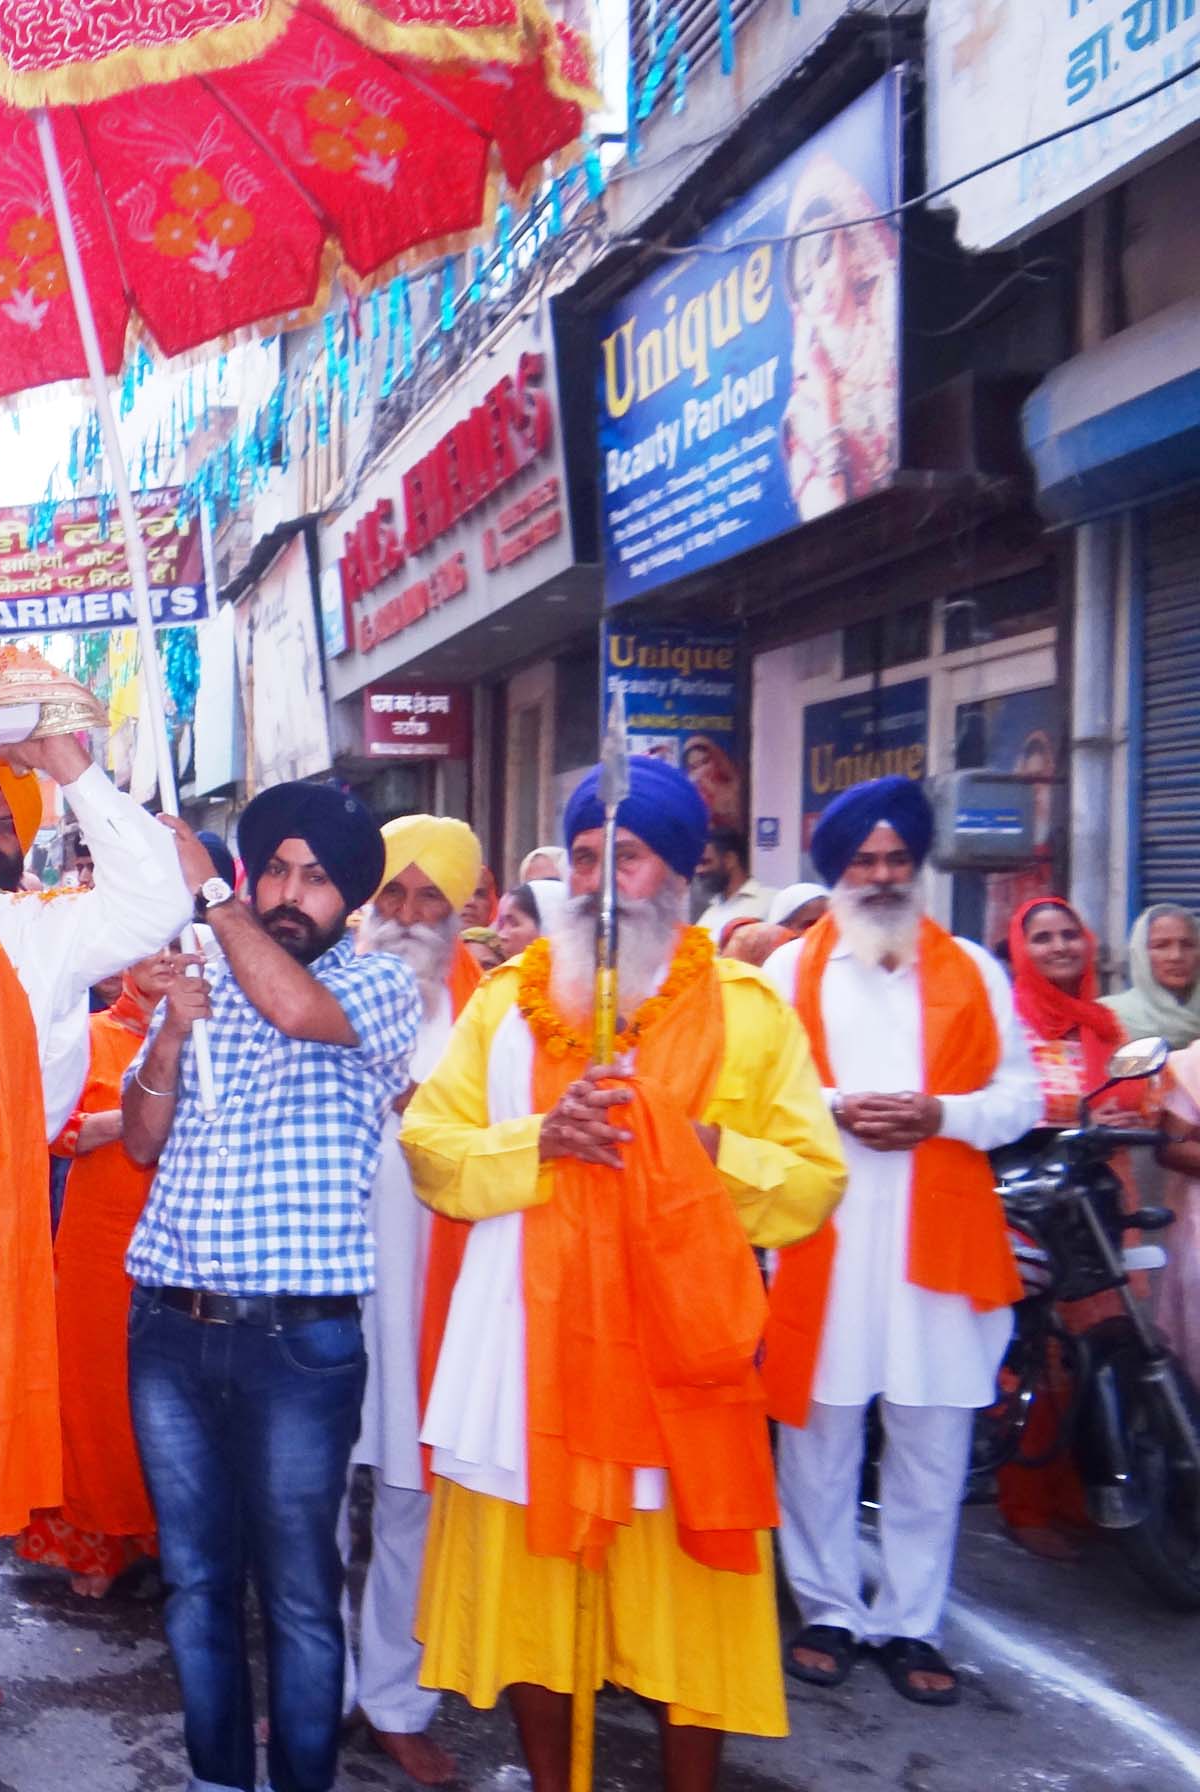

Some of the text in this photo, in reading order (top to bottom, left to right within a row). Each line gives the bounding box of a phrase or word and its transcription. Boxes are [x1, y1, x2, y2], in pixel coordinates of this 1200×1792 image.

[603, 243, 773, 419] Unique
[606, 356, 779, 495] Beauty Parlour
[58, 574, 84, 591] पर
[609, 634, 734, 677] Unique
